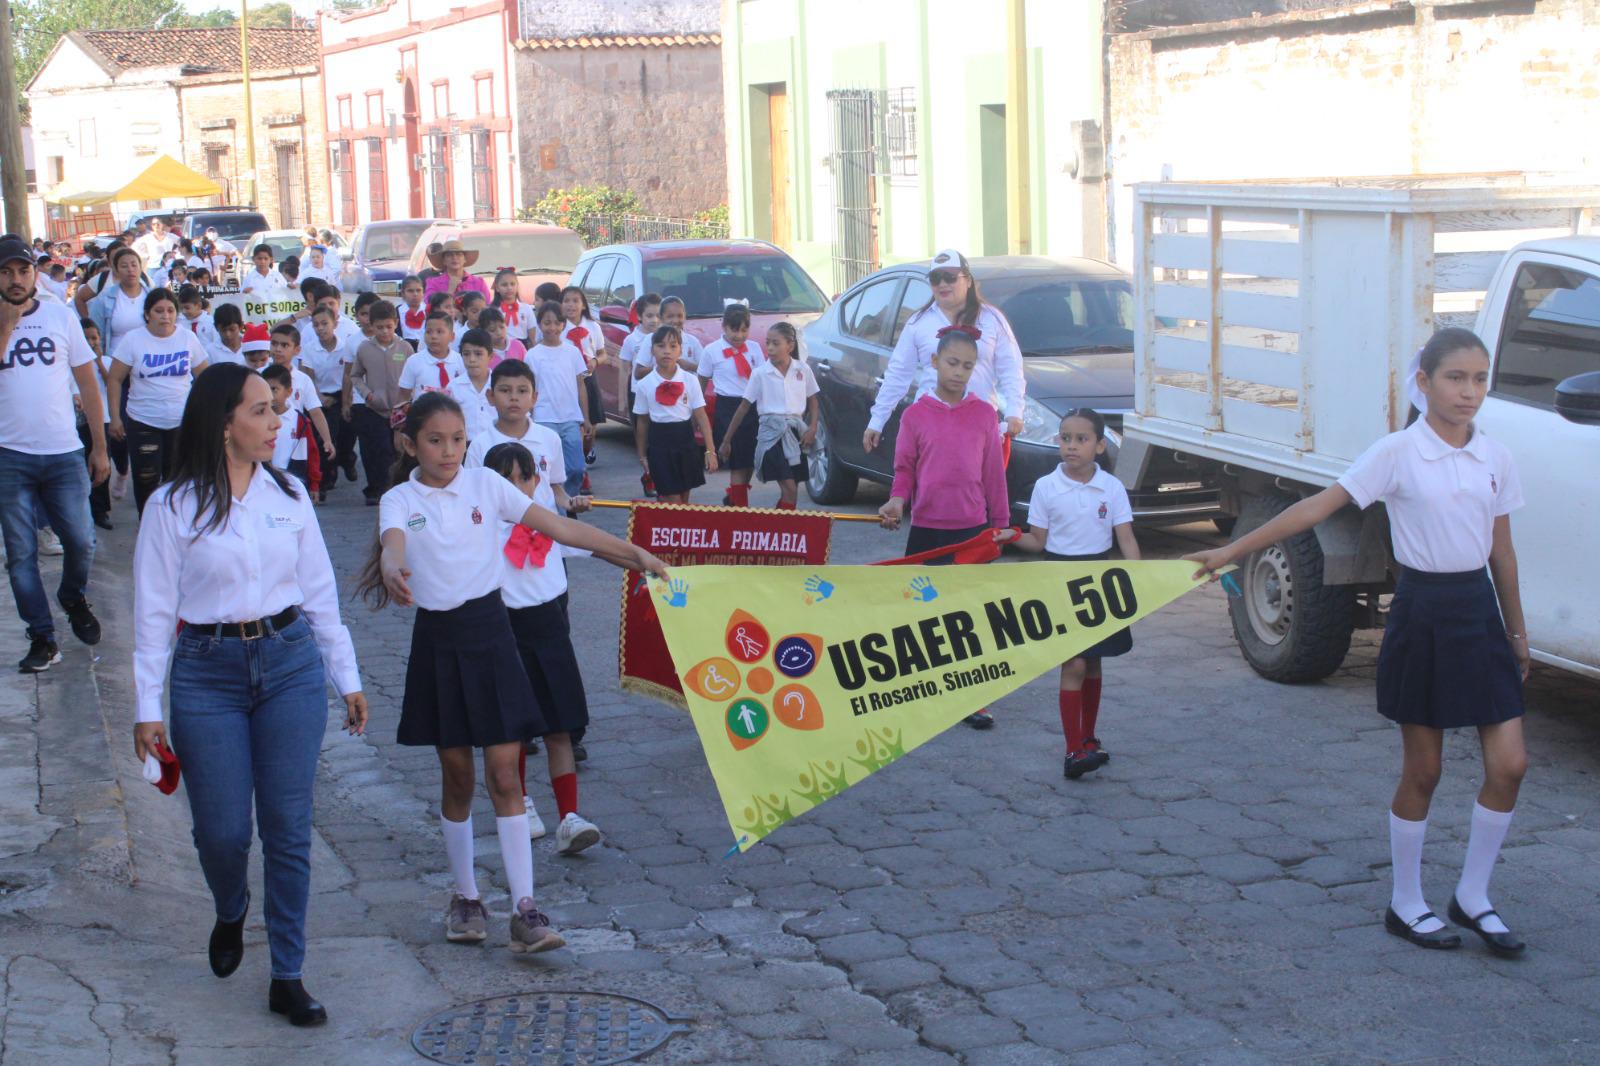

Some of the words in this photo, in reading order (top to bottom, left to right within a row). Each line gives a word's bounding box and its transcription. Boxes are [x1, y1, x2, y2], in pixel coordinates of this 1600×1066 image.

[245, 301, 306, 316] Personas
[139, 350, 190, 379] NIKE
[651, 527, 720, 548] ESCUELA
[731, 530, 808, 554] PRIMARIA
[827, 609, 983, 691] USAER
[983, 597, 1067, 650] No.
[1066, 567, 1138, 628] 50
[850, 697, 869, 717] El
[868, 679, 943, 712] Rosario,
[943, 659, 1016, 692] Sinaloa.
